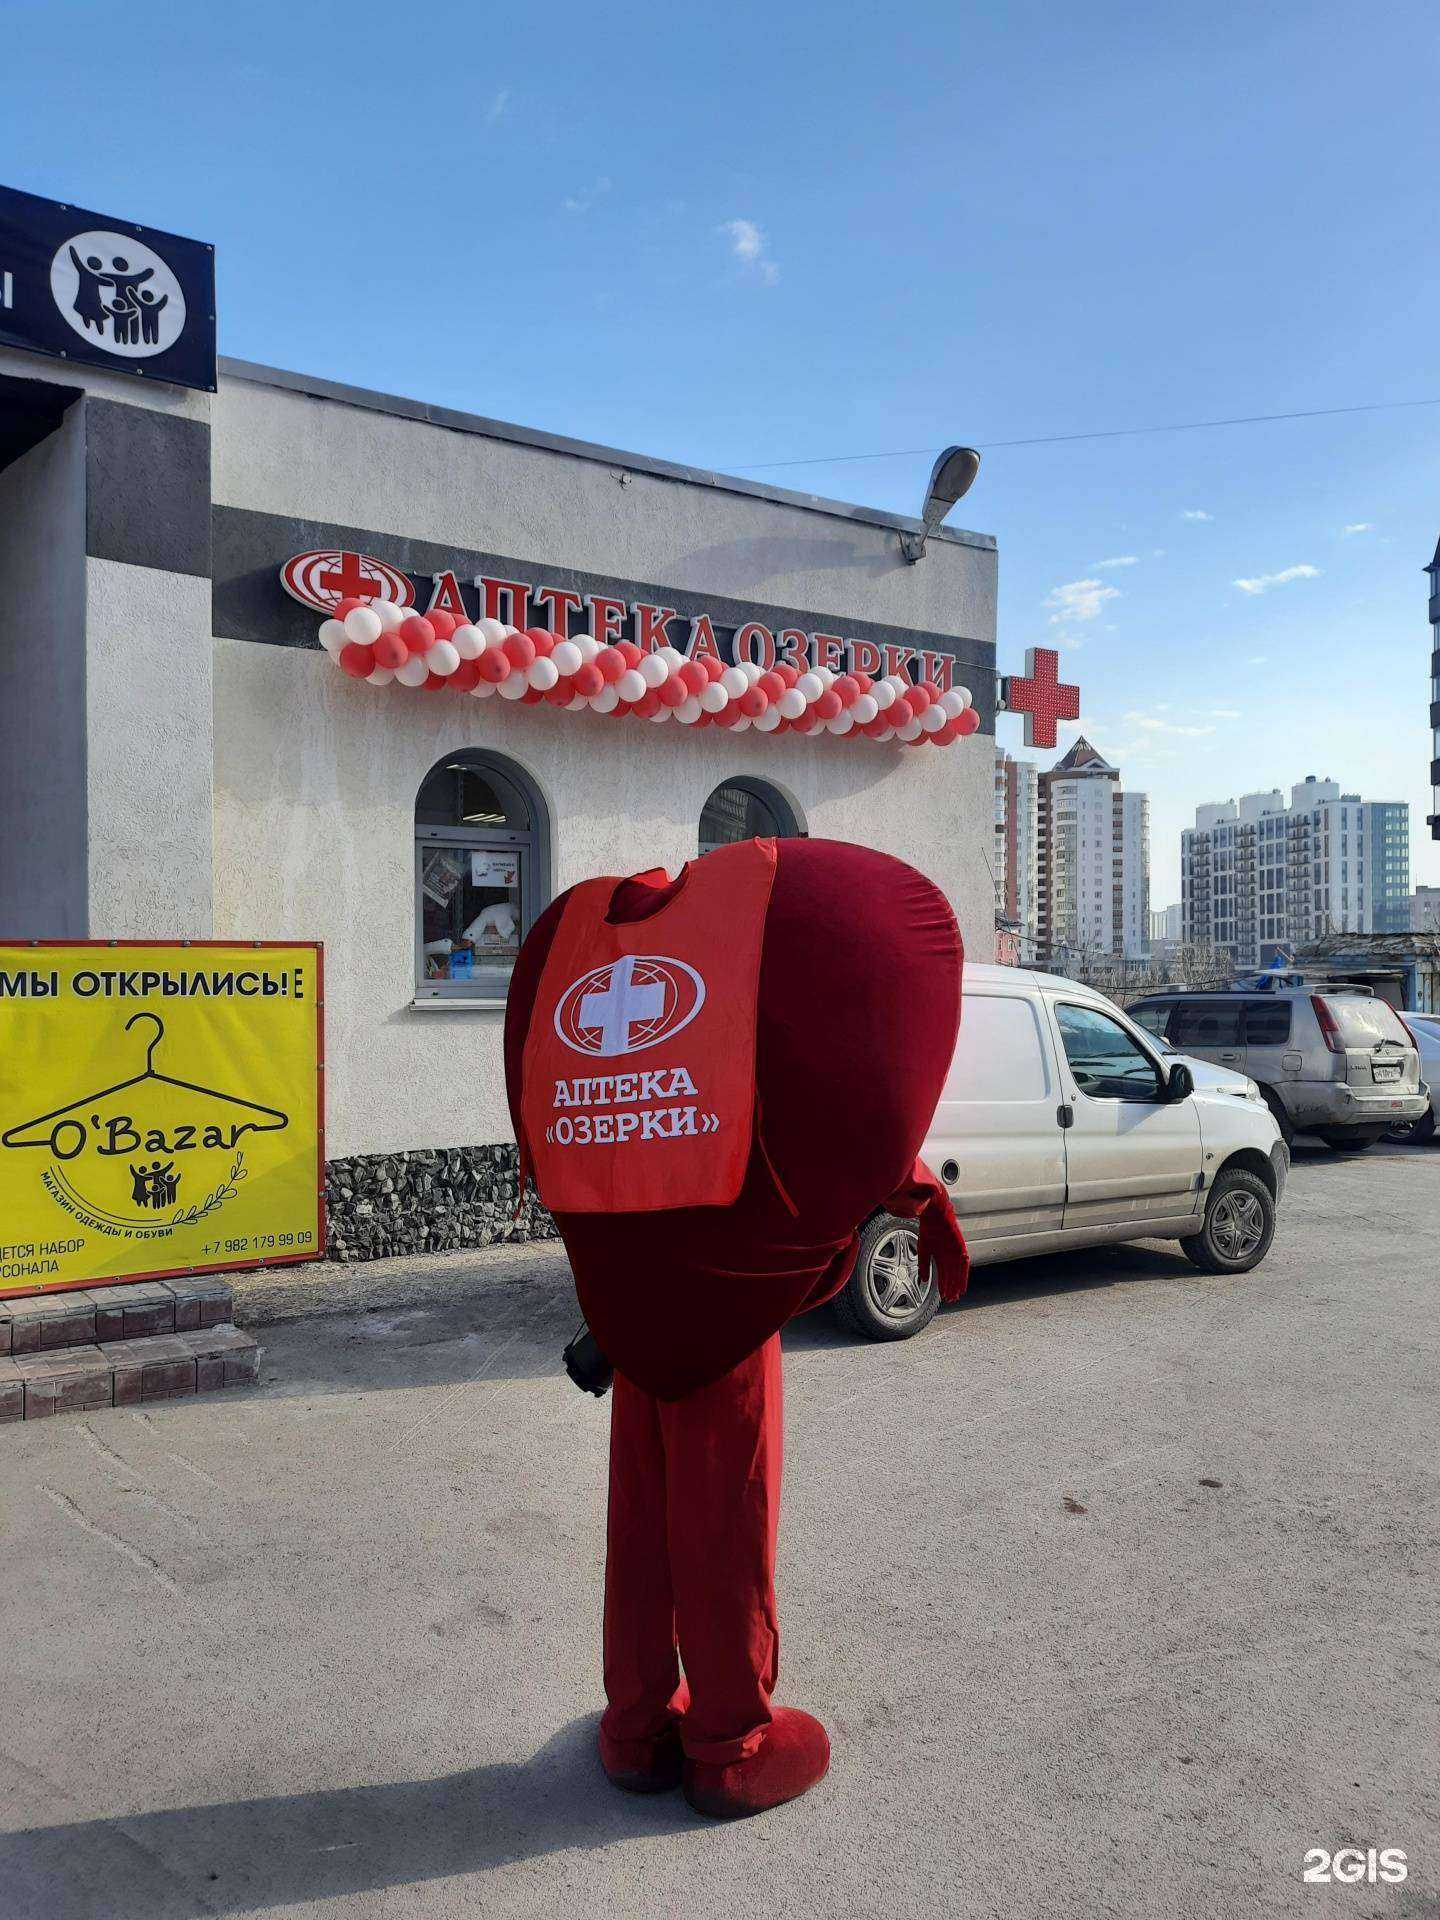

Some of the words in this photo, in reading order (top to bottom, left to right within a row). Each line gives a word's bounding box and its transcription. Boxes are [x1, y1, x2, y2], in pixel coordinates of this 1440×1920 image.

[425, 569, 720, 664] АПТЕКА
[732, 622, 956, 692] ОЗЕРКИ
[0, 971, 58, 997] МЫ
[72, 971, 287, 997] ОТКРЫЛИСЬ!
[553, 1067, 698, 1108] АПТЕКА
[50, 1114, 254, 1160] O'Bazar
[546, 1106, 719, 1145] «ОЗЕРКИ»
[40, 1171, 76, 1213] МАГАЗИН
[75, 1212, 121, 1237] ОДЕЖДЫ
[124, 1230, 132, 1238] И
[135, 1228, 173, 1239] ОБУВИ
[40, 1239, 85, 1256] НАБОР
[201, 1241, 220, 1255] +7
[224, 1238, 248, 1252] 982
[252, 1235, 275, 1249] 179
[278, 1232, 294, 1246] 99
[297, 1231, 312, 1244] 09
[0, 1259, 59, 1278] СОНАЛА
